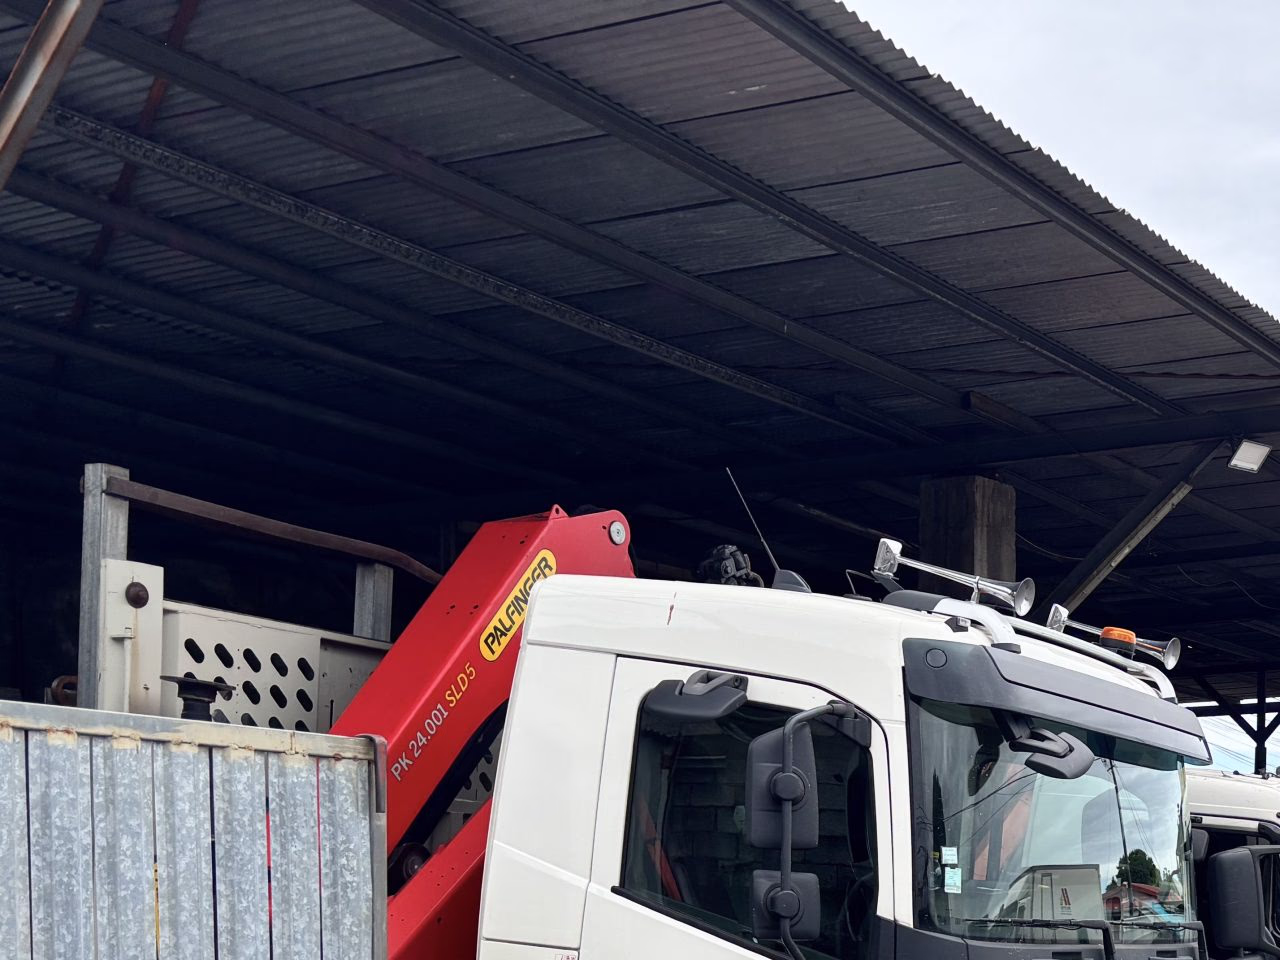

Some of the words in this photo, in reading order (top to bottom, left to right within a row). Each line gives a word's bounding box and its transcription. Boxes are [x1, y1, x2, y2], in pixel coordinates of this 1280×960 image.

[484, 557, 553, 655] PALFINGER
[391, 752, 413, 781] PK
[409, 703, 448, 757] 24.001
